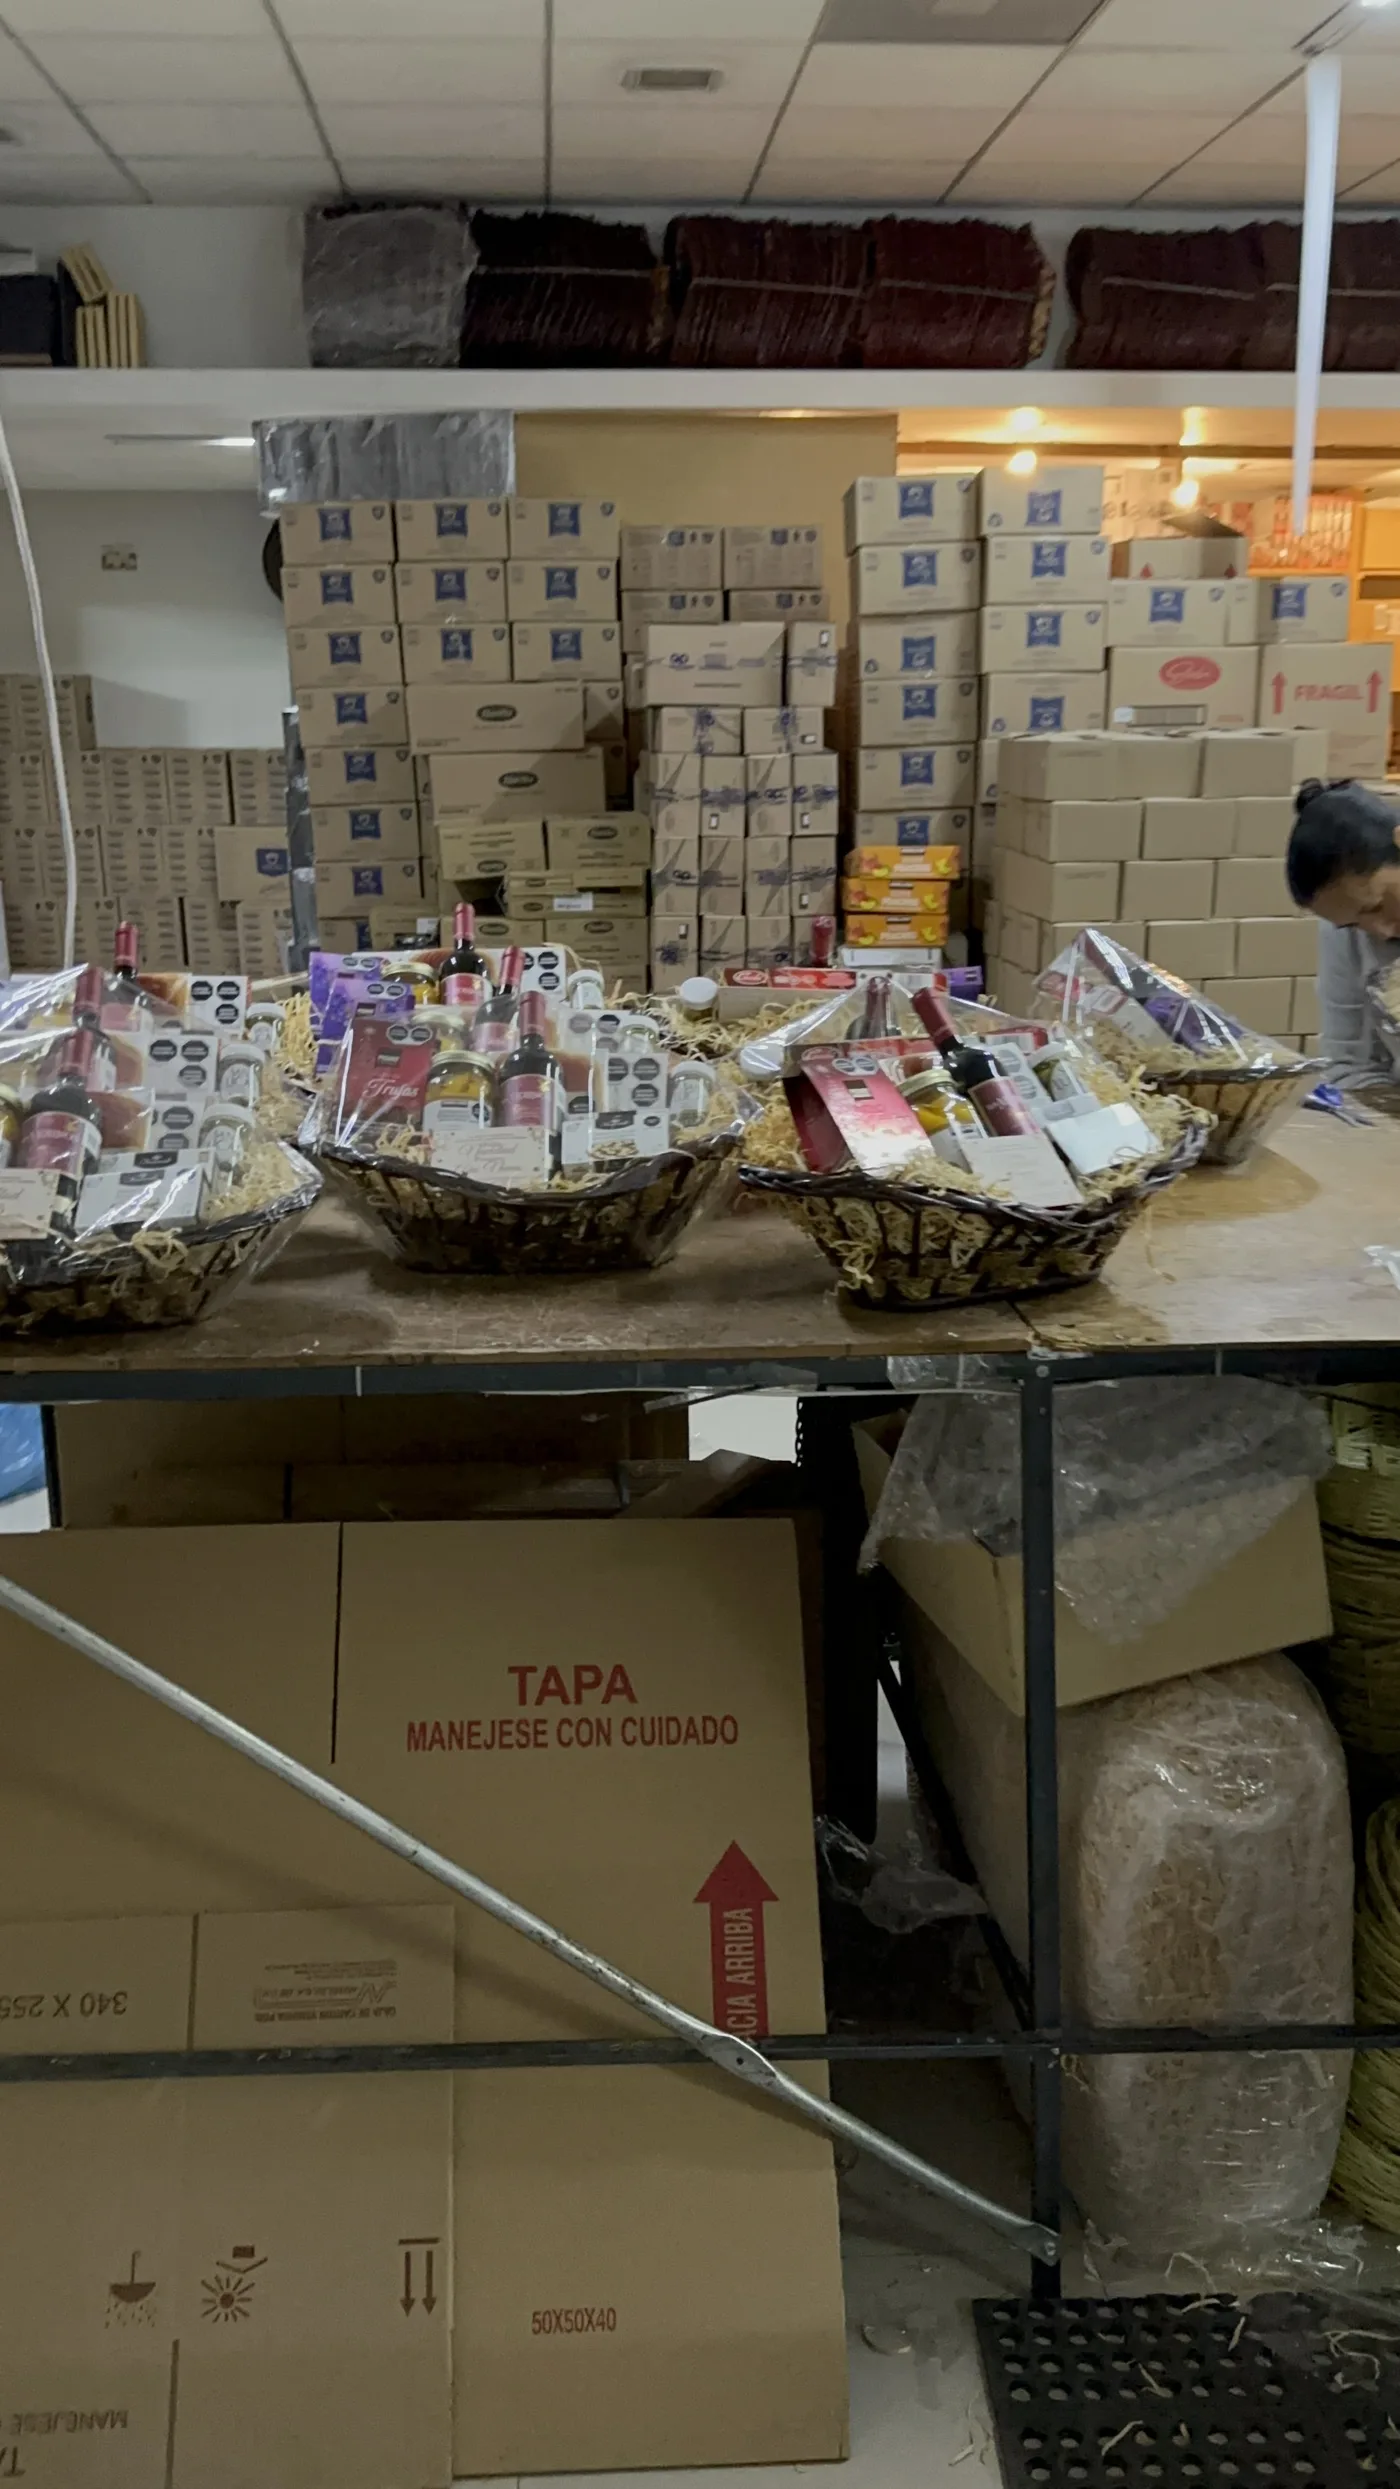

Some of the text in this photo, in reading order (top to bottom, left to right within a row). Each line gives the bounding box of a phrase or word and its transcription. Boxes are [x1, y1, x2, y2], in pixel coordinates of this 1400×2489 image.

[362, 1078, 420, 1101] Trufas
[507, 1664, 638, 1707] TAPA
[406, 1714, 739, 1753] MANEJESE CON CUIDADO
[723, 1908, 756, 1986] ARRIBA
[52, 1994, 71, 2018] X
[79, 1991, 128, 2018] 340
[531, 2307, 617, 2335] 50X50X40
